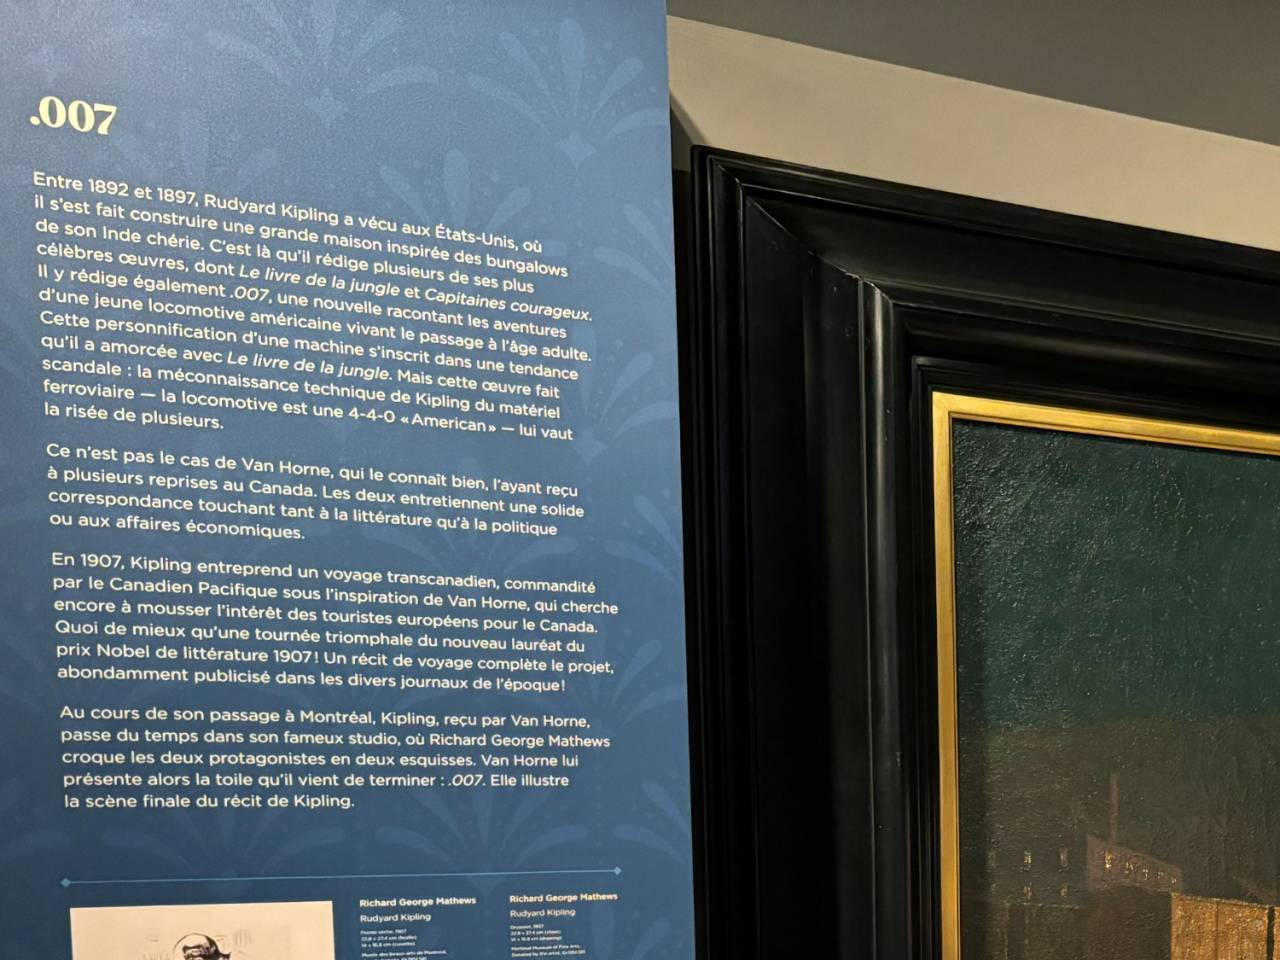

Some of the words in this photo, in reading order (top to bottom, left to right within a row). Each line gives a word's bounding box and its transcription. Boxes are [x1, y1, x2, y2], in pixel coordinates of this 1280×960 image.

[29, 95, 118, 136] .007
[33, 171, 84, 191] Entre
[90, 178, 129, 197] 1892
[133, 186, 153, 200] et
[159, 187, 199, 208] 1897,
[204, 193, 276, 216] Rudyard
[281, 203, 339, 226] Kipling
[343, 215, 354, 226] a
[358, 215, 397, 232] vécu
[401, 223, 431, 237] aux
[435, 223, 519, 251] États-Unis,
[522, 240, 542, 253] où
[35, 194, 44, 209] il
[50, 197, 91, 215] s'est
[95, 202, 125, 219] fait
[129, 209, 218, 230] construire
[222, 221, 255, 235] une
[259, 225, 319, 243] grande
[323, 234, 382, 252] maison
[387, 239, 450, 261] inspirée
[454, 250, 482, 265] des
[486, 253, 568, 277] bungalows
[40, 310, 90, 328] Cette
[95, 318, 237, 343] personnification
[242, 330, 289, 348] d'une
[294, 339, 365, 356] machine
[369, 345, 430, 364] s'inscrit
[434, 352, 472, 369] dans
[476, 359, 505, 372] une
[509, 361, 579, 381] tendance
[45, 401, 60, 416] la
[65, 404, 108, 420] risée
[113, 407, 137, 422] de
[141, 410, 224, 429] plusieurs.
[49, 514, 73, 526] ou
[78, 515, 111, 527] aux
[116, 515, 181, 532] affaires
[185, 519, 305, 540] économiques.
[52, 552, 75, 566] En
[81, 553, 125, 570] 1907,
[130, 556, 192, 574] Kipling
[197, 561, 293, 577] entreprend
[297, 568, 319, 579] un
[323, 569, 383, 584] voyage
[387, 571, 500, 590] transcanadien,
[504, 579, 596, 594] commandité
[57, 664, 189, 681] abondamment
[194, 669, 271, 684] publicisé
[275, 671, 316, 685] dans
[320, 672, 343, 686] les
[347, 673, 397, 687] divers
[400, 675, 468, 690] journaux
[472, 677, 492, 690] de
[496, 677, 565, 693] l'époque!
[61, 730, 112, 743] passe
[116, 728, 139, 742] du
[144, 729, 199, 744] temps
[203, 729, 245, 743] dans
[249, 733, 279, 743] son
[283, 730, 344, 744] fameux
[348, 732, 401, 747] studio,
[405, 733, 425, 746] où
[429, 733, 487, 746] Richard
[491, 734, 545, 749] George
[548, 734, 611, 748] Mathews
[64, 794, 80, 808] la
[85, 794, 138, 808] scène
[143, 794, 191, 808] finale
[196, 794, 218, 808] du
[223, 794, 262, 808] récit
[267, 794, 289, 808] de
[294, 794, 355, 810] Kipling.
[359, 898, 397, 907] Richard
[399, 898, 434, 907] George
[436, 897, 477, 905] Mathews
[509, 894, 544, 903] Richard
[545, 894, 578, 903] George
[580, 893, 618, 901] Mathews
[360, 914, 399, 923] Rudyard
[400, 913, 432, 922] Kipling
[510, 909, 546, 918] Rudyard
[547, 909, 576, 917] Kipling
